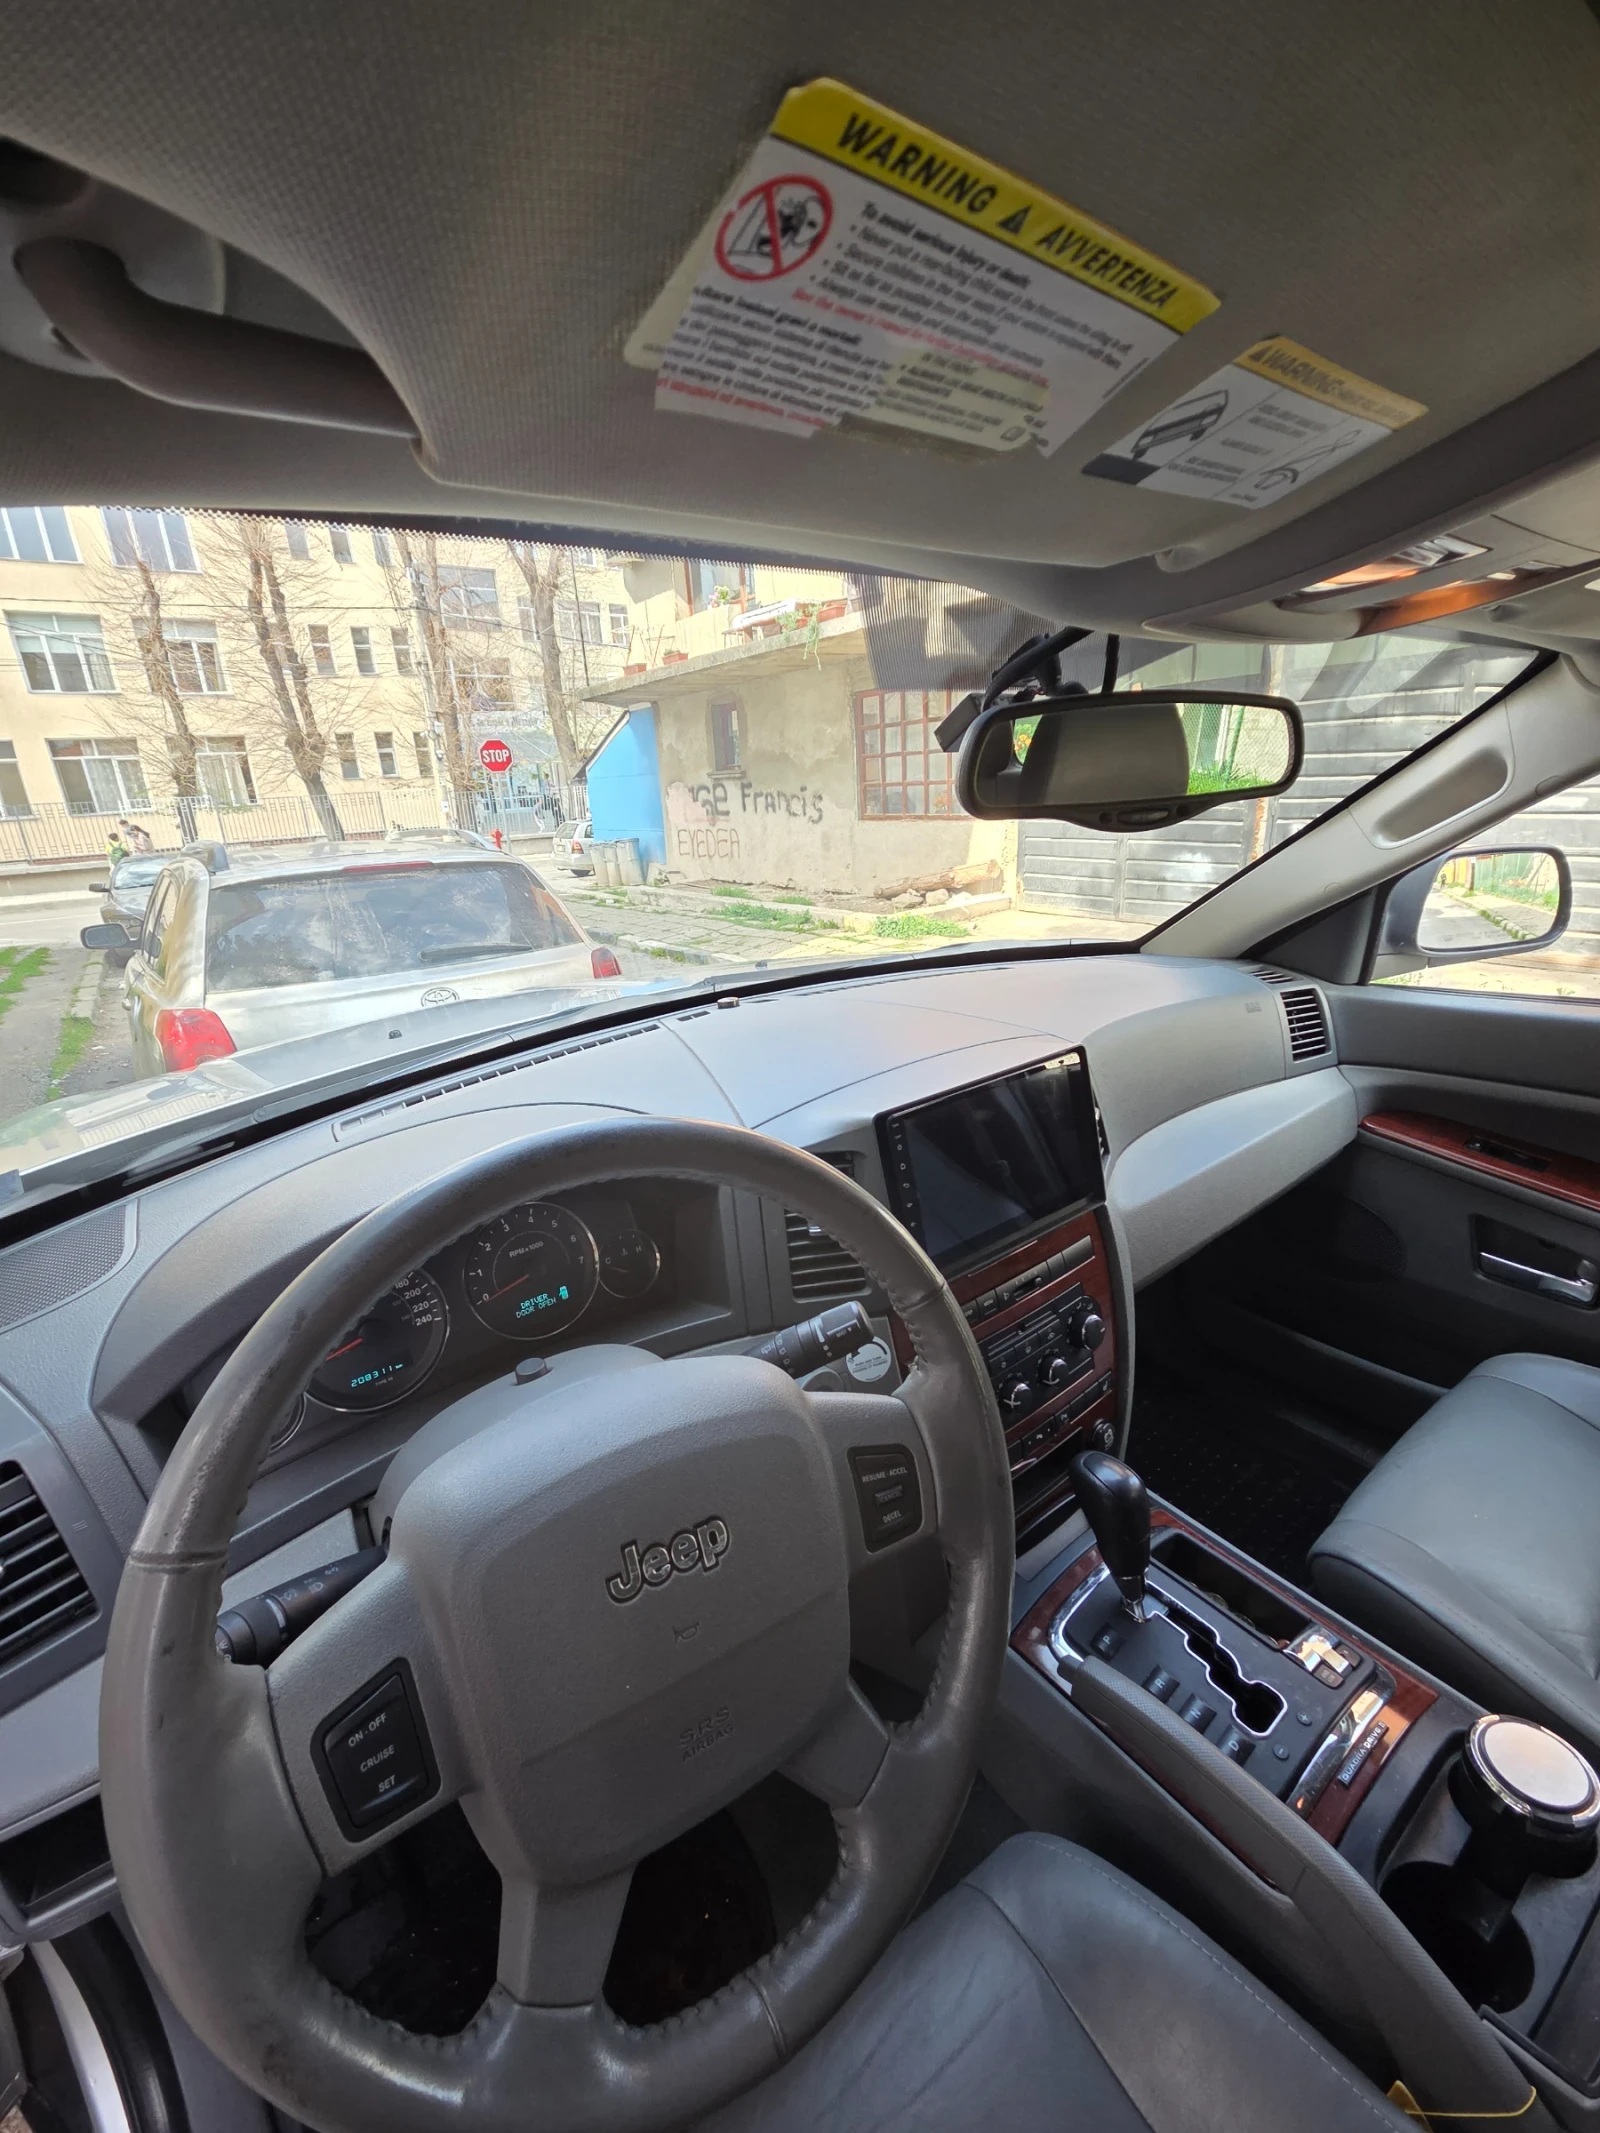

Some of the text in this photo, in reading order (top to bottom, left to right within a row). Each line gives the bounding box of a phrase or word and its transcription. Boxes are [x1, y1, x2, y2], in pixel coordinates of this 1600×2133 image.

[837, 113, 1181, 309] WARNING AVVERTENZA
[482, 749, 510, 763] STOP
[740, 782, 824, 825] Francis
[677, 828, 740, 859] EYEDEA
[503, 1224, 510, 1232] 3
[485, 1243, 492, 1251] 2
[404, 1288, 421, 1299] 200
[520, 1293, 548, 1309] DRIVER
[412, 1301, 429, 1313] 220
[516, 1297, 557, 1318] DOOR OPEN
[415, 1314, 432, 1326] 240
[351, 1365, 393, 1388] 208311
[861, 1466, 907, 1483] RESUME ACCEL
[883, 1510, 902, 1523] DECEL
[606, 1516, 730, 1602] Jeep
[1102, 1635, 1111, 1645] P
[1154, 1678, 1166, 1689] R
[679, 1705, 731, 1747] SRS
[682, 1723, 734, 1763] AIRBAG
[1227, 1740, 1239, 1752] D
[360, 1744, 395, 1773] CRUISE
[378, 1774, 396, 1793] SET
